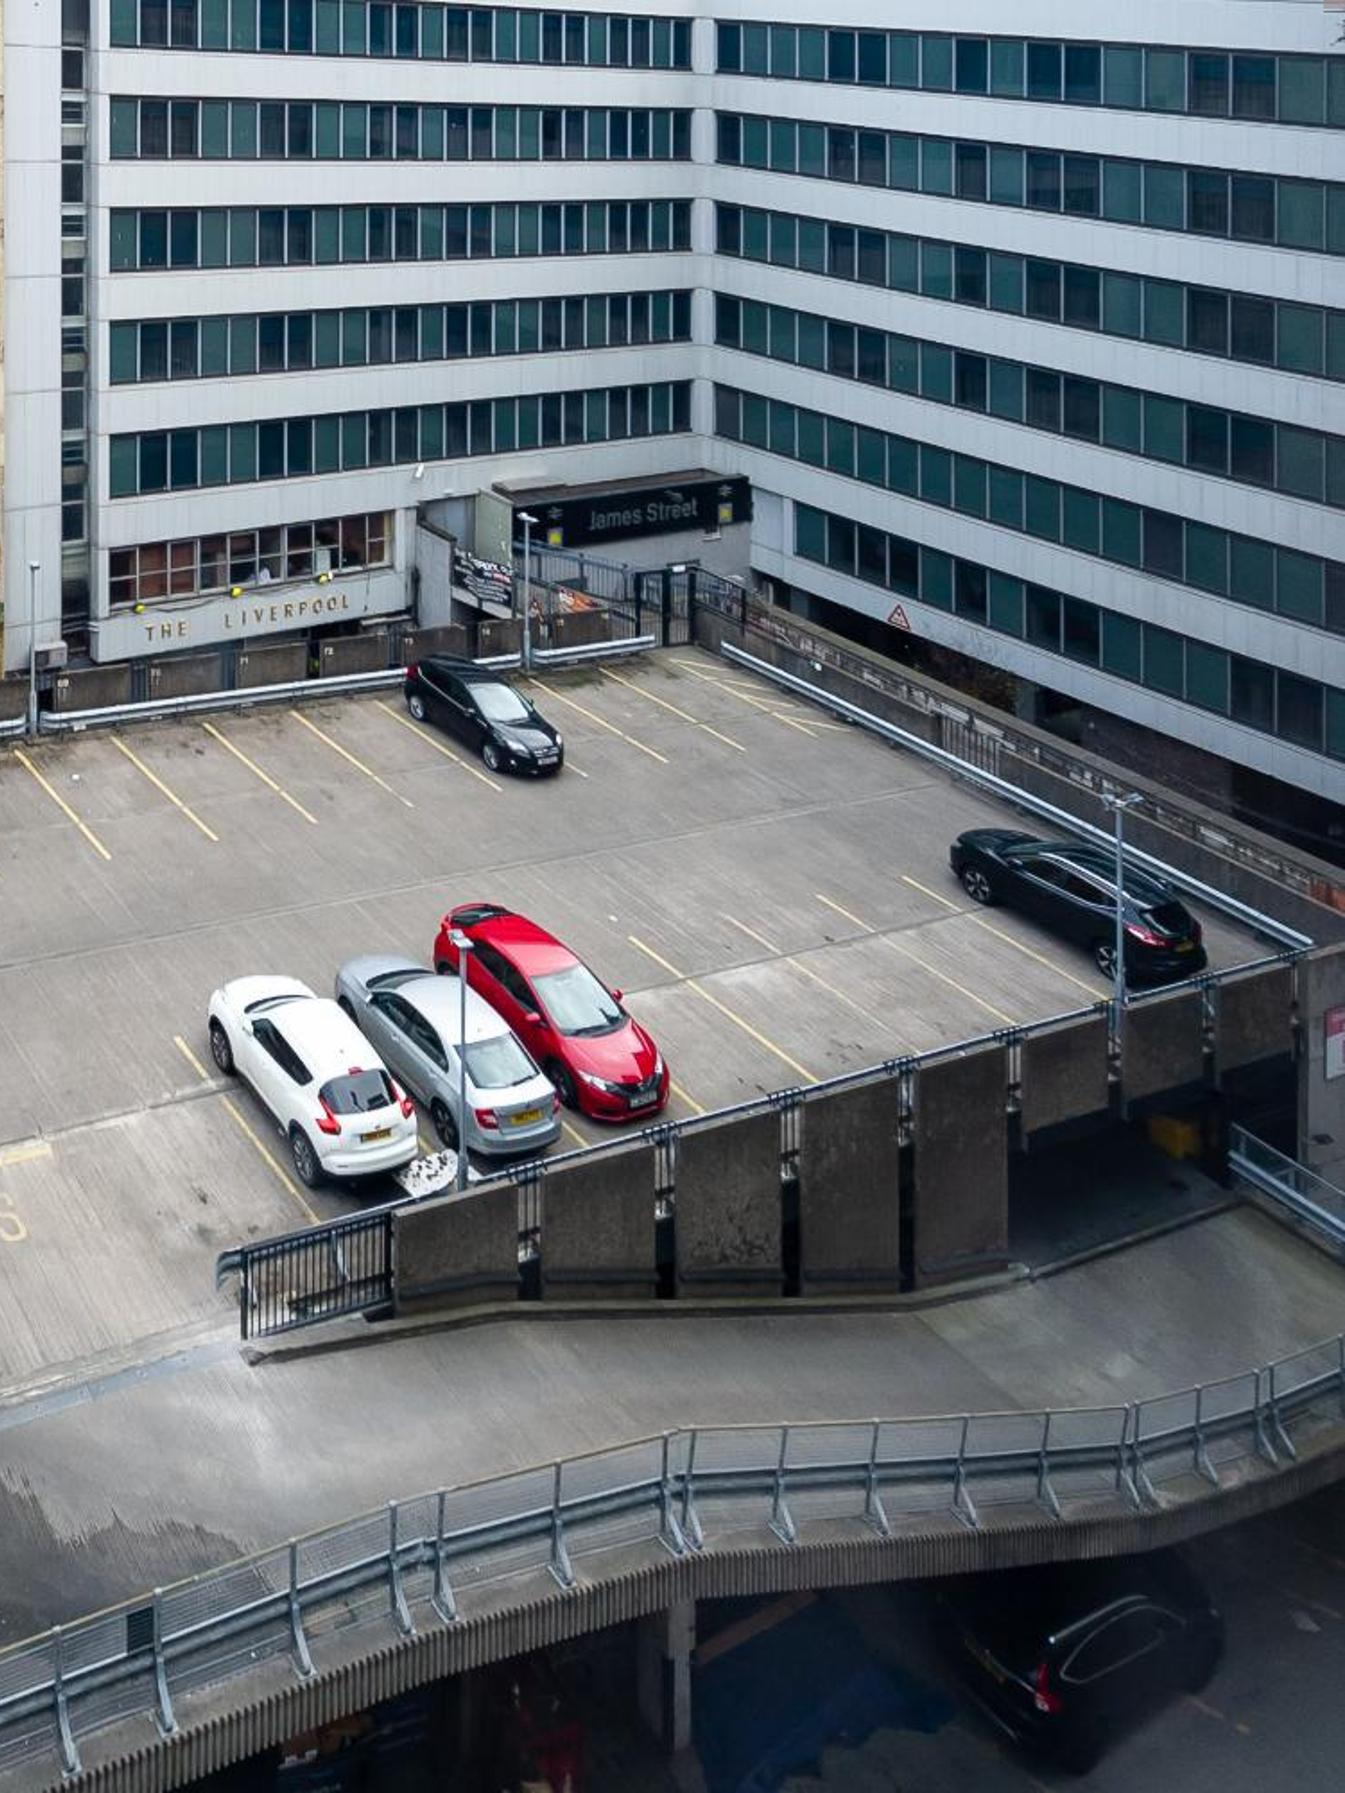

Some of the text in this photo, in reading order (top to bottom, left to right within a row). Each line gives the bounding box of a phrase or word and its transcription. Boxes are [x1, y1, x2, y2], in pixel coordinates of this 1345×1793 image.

[589, 498, 698, 531] James Street
[145, 594, 350, 641] THE LIVERPOOL
